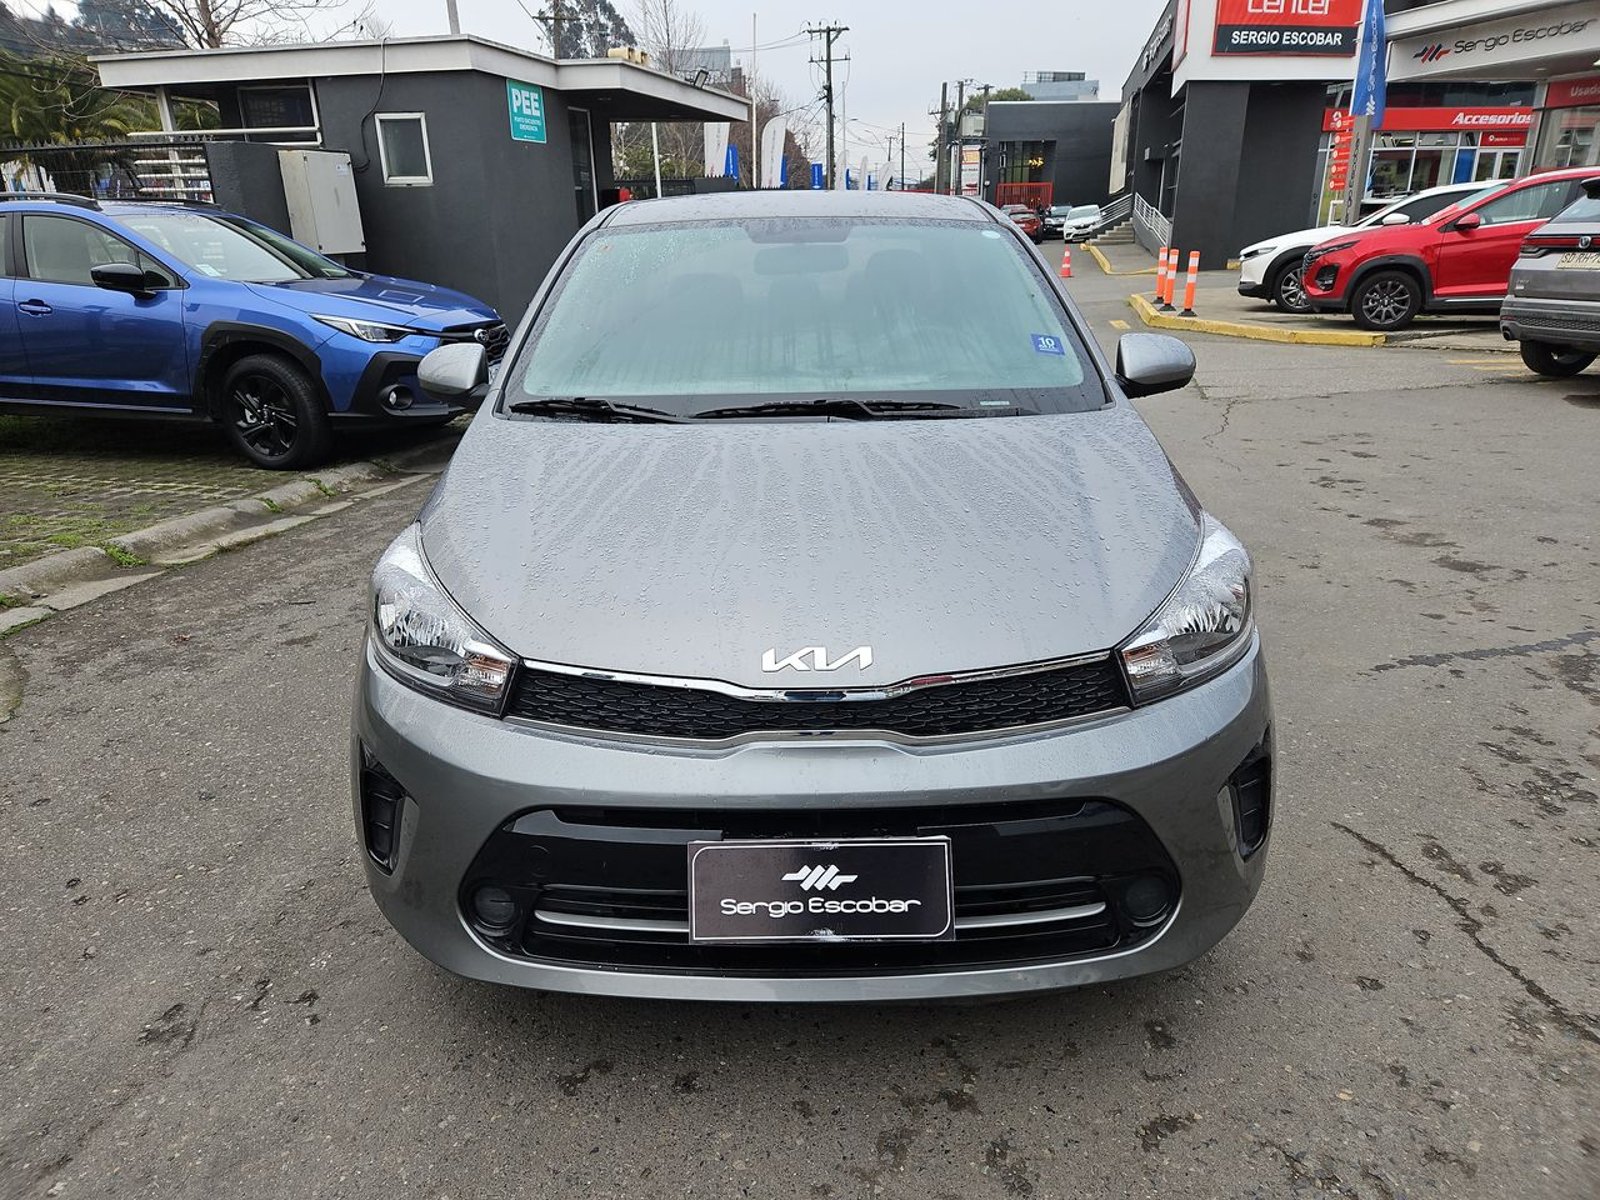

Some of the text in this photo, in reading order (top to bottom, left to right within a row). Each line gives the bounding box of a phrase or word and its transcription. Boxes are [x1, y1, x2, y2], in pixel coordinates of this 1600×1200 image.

[1231, 31, 1343, 46] SERGIO ESCOBAR
[1454, 17, 1599, 54] Sergio Escobar
[511, 88, 541, 116] PEE
[1452, 112, 1536, 125] Accesorios
[1038, 336, 1055, 347] 10
[761, 645, 874, 672] KIA
[720, 896, 922, 918] Sergio Escobar
